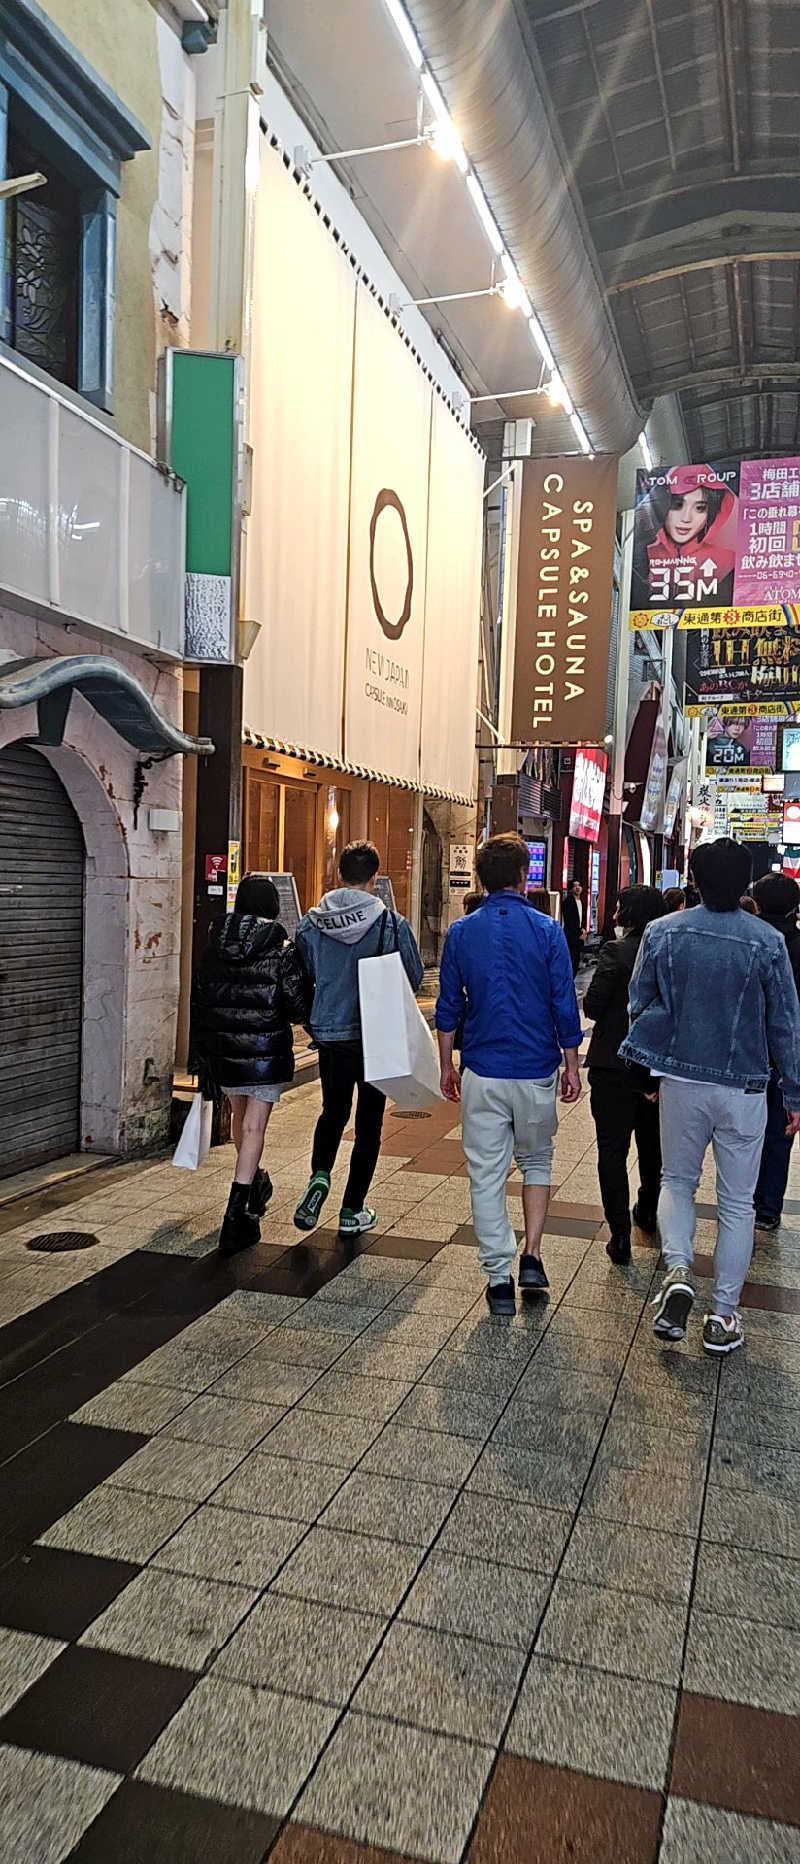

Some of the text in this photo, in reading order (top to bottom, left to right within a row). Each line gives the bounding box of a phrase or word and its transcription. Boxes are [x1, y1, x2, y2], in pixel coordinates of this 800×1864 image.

[749, 521, 786, 536] 1時間
[749, 536, 786, 554] 初回
[533, 473, 564, 728] CAPSULE HOTEL
[564, 500, 594, 701] SPA&SAUNA
[385, 659, 409, 689] JAPAN
[316, 911, 367, 930] CELINE
